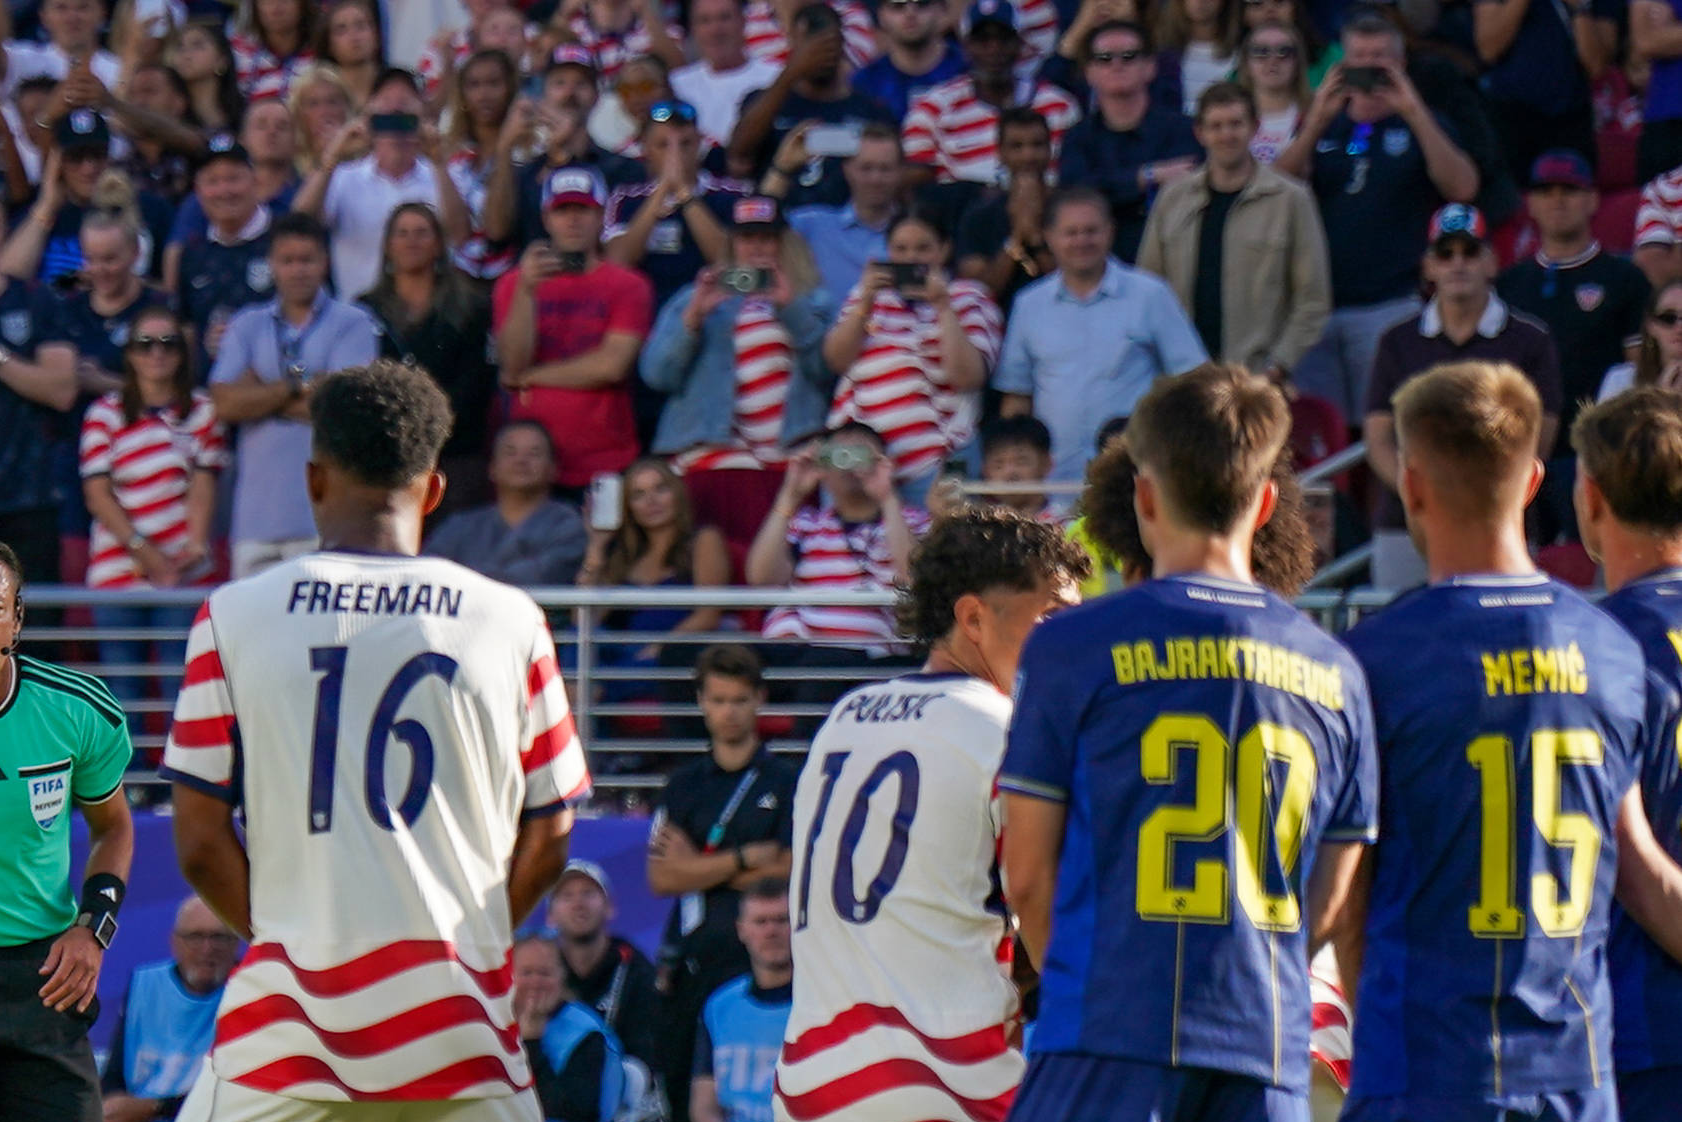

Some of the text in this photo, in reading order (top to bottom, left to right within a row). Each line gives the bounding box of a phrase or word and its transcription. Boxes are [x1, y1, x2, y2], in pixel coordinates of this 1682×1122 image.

[287, 580, 462, 617] FREEMAN
[1481, 641, 1588, 698] MEMIĆ
[33, 778, 64, 796] FIFA
[309, 646, 459, 835] 16
[796, 750, 920, 932] 10
[1136, 712, 1317, 934] 20
[1466, 729, 1605, 939] 15
[714, 1046, 778, 1092] FIF
